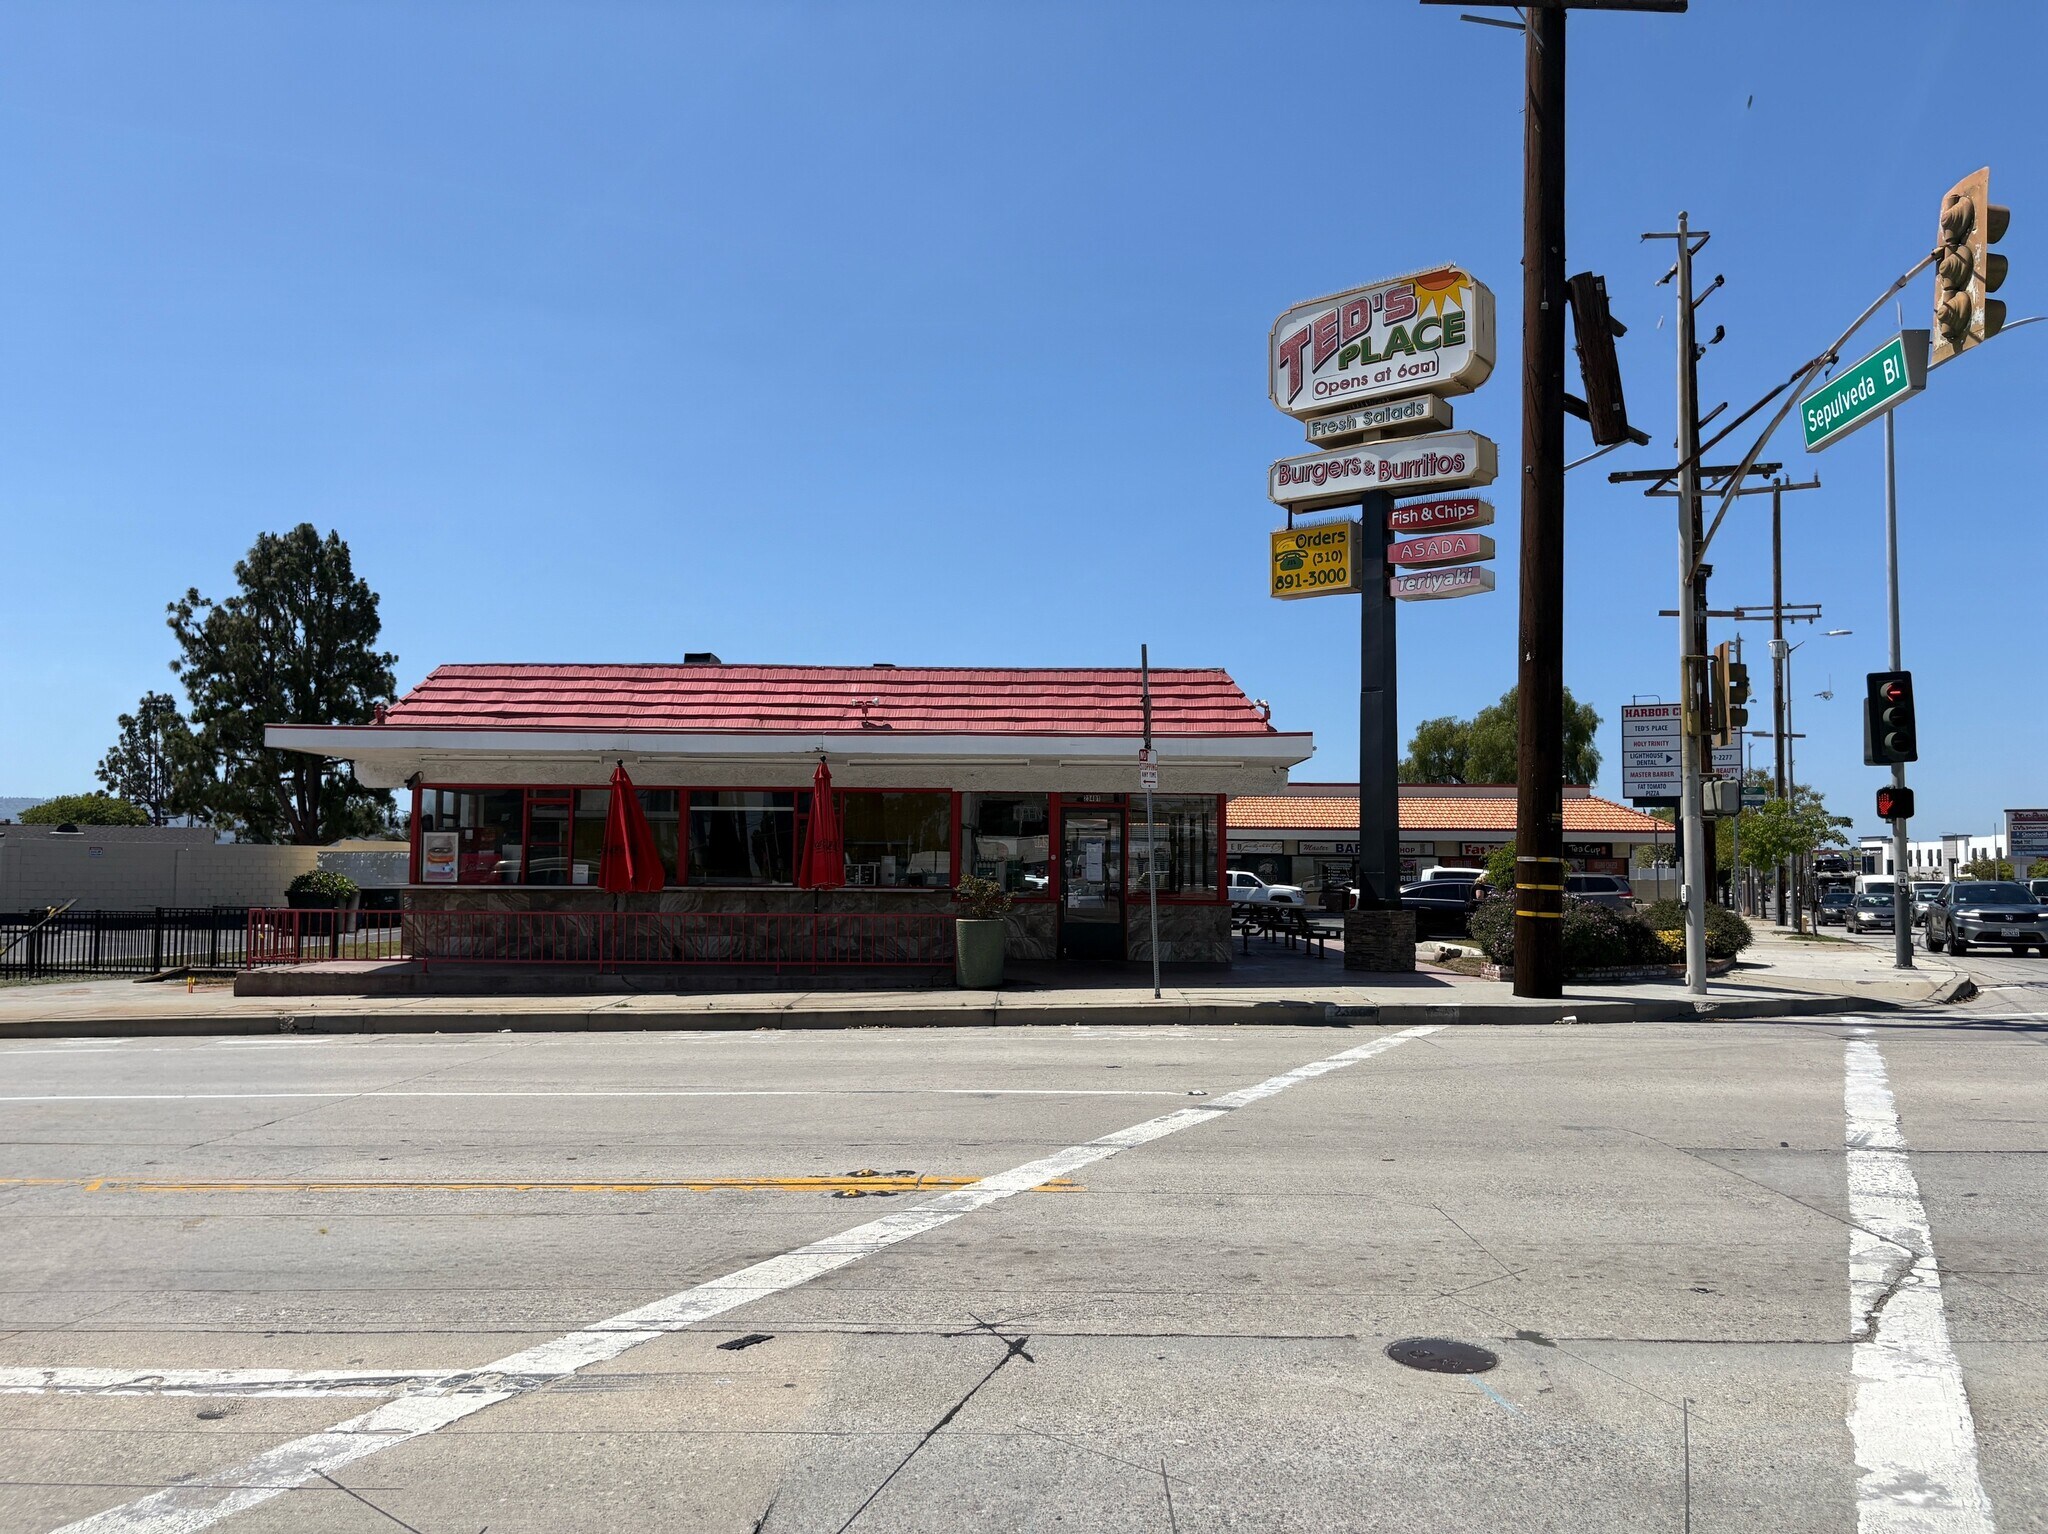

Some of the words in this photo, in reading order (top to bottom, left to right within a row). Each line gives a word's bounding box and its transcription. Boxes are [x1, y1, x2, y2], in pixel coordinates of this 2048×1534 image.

[1279, 283, 1417, 404] TED'S
[1337, 310, 1465, 370] PLACE
[1314, 374, 1369, 396] Opens
[1374, 369, 1393, 383] at
[1399, 359, 1436, 378] 6am
[1808, 376, 1875, 431] Sepulveda
[1883, 355, 1900, 385] Bl
[1312, 415, 1357, 437] Fresh
[1363, 401, 1425, 425] Salads
[1278, 456, 1361, 486] Burgers
[1364, 460, 1375, 475] &
[1379, 451, 1465, 482] Burritos
[1392, 510, 1417, 525] Fish
[1421, 508, 1432, 521] &
[1435, 503, 1476, 522] Chips
[1296, 530, 1346, 549] Orders
[1401, 538, 1466, 559] ASADA
[1312, 549, 1343, 565] (310)
[1275, 567, 1347, 590] 891-3000
[1398, 568, 1473, 593] Teriyaki
[1625, 706, 1669, 718] HARBOR
[1648, 740, 1669, 748] TRINITY
[1303, 843, 1329, 851] Master
[1464, 844, 1486, 855] Fat
[1568, 844, 1583, 853] Tea
[1584, 845, 1601, 855] Cup
